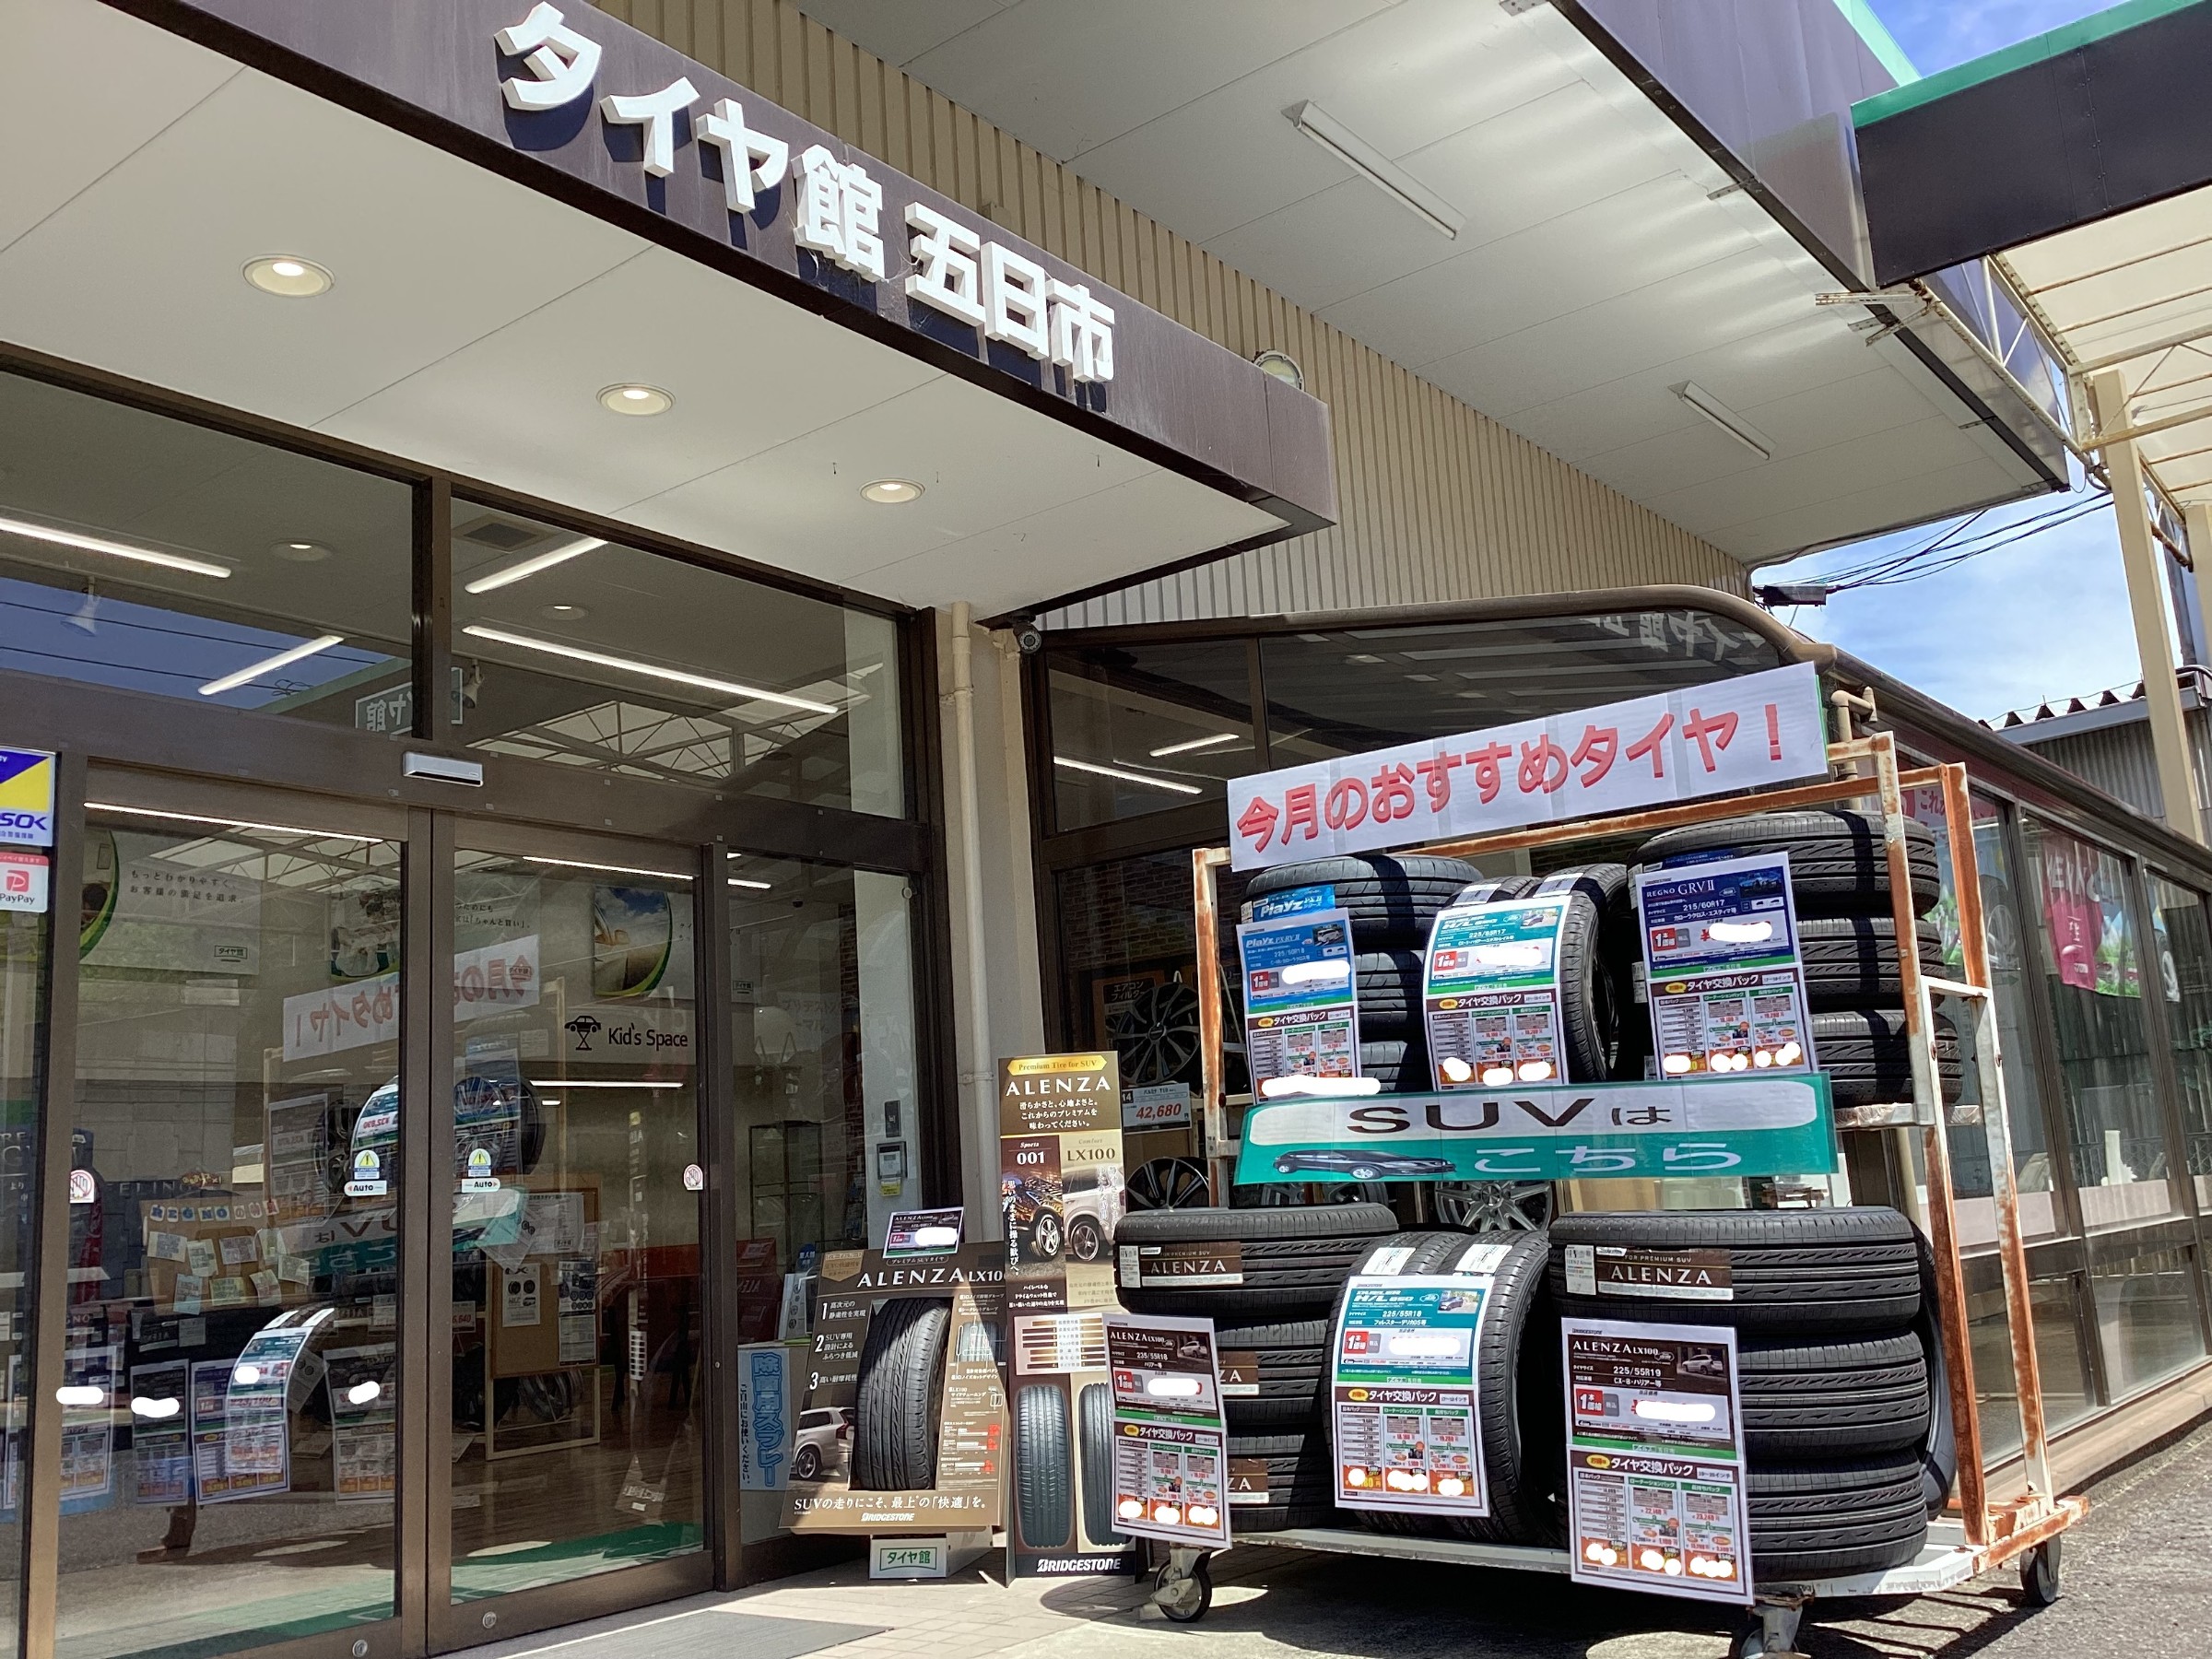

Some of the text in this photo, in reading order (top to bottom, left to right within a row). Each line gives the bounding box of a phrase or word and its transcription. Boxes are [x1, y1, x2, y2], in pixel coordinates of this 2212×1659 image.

[494, 1, 1115, 382] タイヤ館 五日市
[1237, 702, 1784, 853] 今月のおすすめタイヤ！
[1646, 888, 1676, 898] REGNO
[1683, 900, 1725, 912] 215/60R17
[1113, 981, 1144, 993] エアコン
[1688, 974, 1759, 992] タイヤ交換パック
[1458, 994, 1522, 1008] タイヤ交換パック
[608, 1022, 688, 1052] Kid's Space
[1018, 1059, 1098, 1071] Premium Tire for SUV
[1006, 1076, 1112, 1097] ALENZA
[1021, 1109, 1098, 1121] これからのプレミアムを
[1135, 1103, 1182, 1121] 42,680
[1029, 1120, 1090, 1130] 味わってください。
[1017, 1151, 1045, 1165] 001
[1067, 1147, 1116, 1161] LX100
[1475, 1141, 1743, 1175] こちら
[353, 1183, 374, 1193] Auto
[474, 1180, 493, 1188] Auto
[1151, 1259, 1227, 1275] ALENZA
[857, 1267, 964, 1288] ALENZA
[969, 1270, 1006, 1283] LX10
[1611, 1265, 1712, 1285] ALENZA
[822, 1302, 828, 1320] 1
[815, 1335, 825, 1352] 2
[1111, 1331, 1147, 1342] ALENZA
[1573, 1340, 1658, 1356] ALENZA LX100
[1613, 1366, 1662, 1377] 225/55R19
[809, 1371, 818, 1390] 3
[1369, 1390, 1437, 1403] タイヤ交換パック
[1139, 1428, 1193, 1441] タイヤ交換パック
[1611, 1458, 1693, 1477] タイヤ交換パック
[861, 1512, 915, 1522] BRIDGESTONE
[887, 1550, 931, 1565] タイヤ館
[1037, 1559, 1121, 1573] BRIDGESTONE
